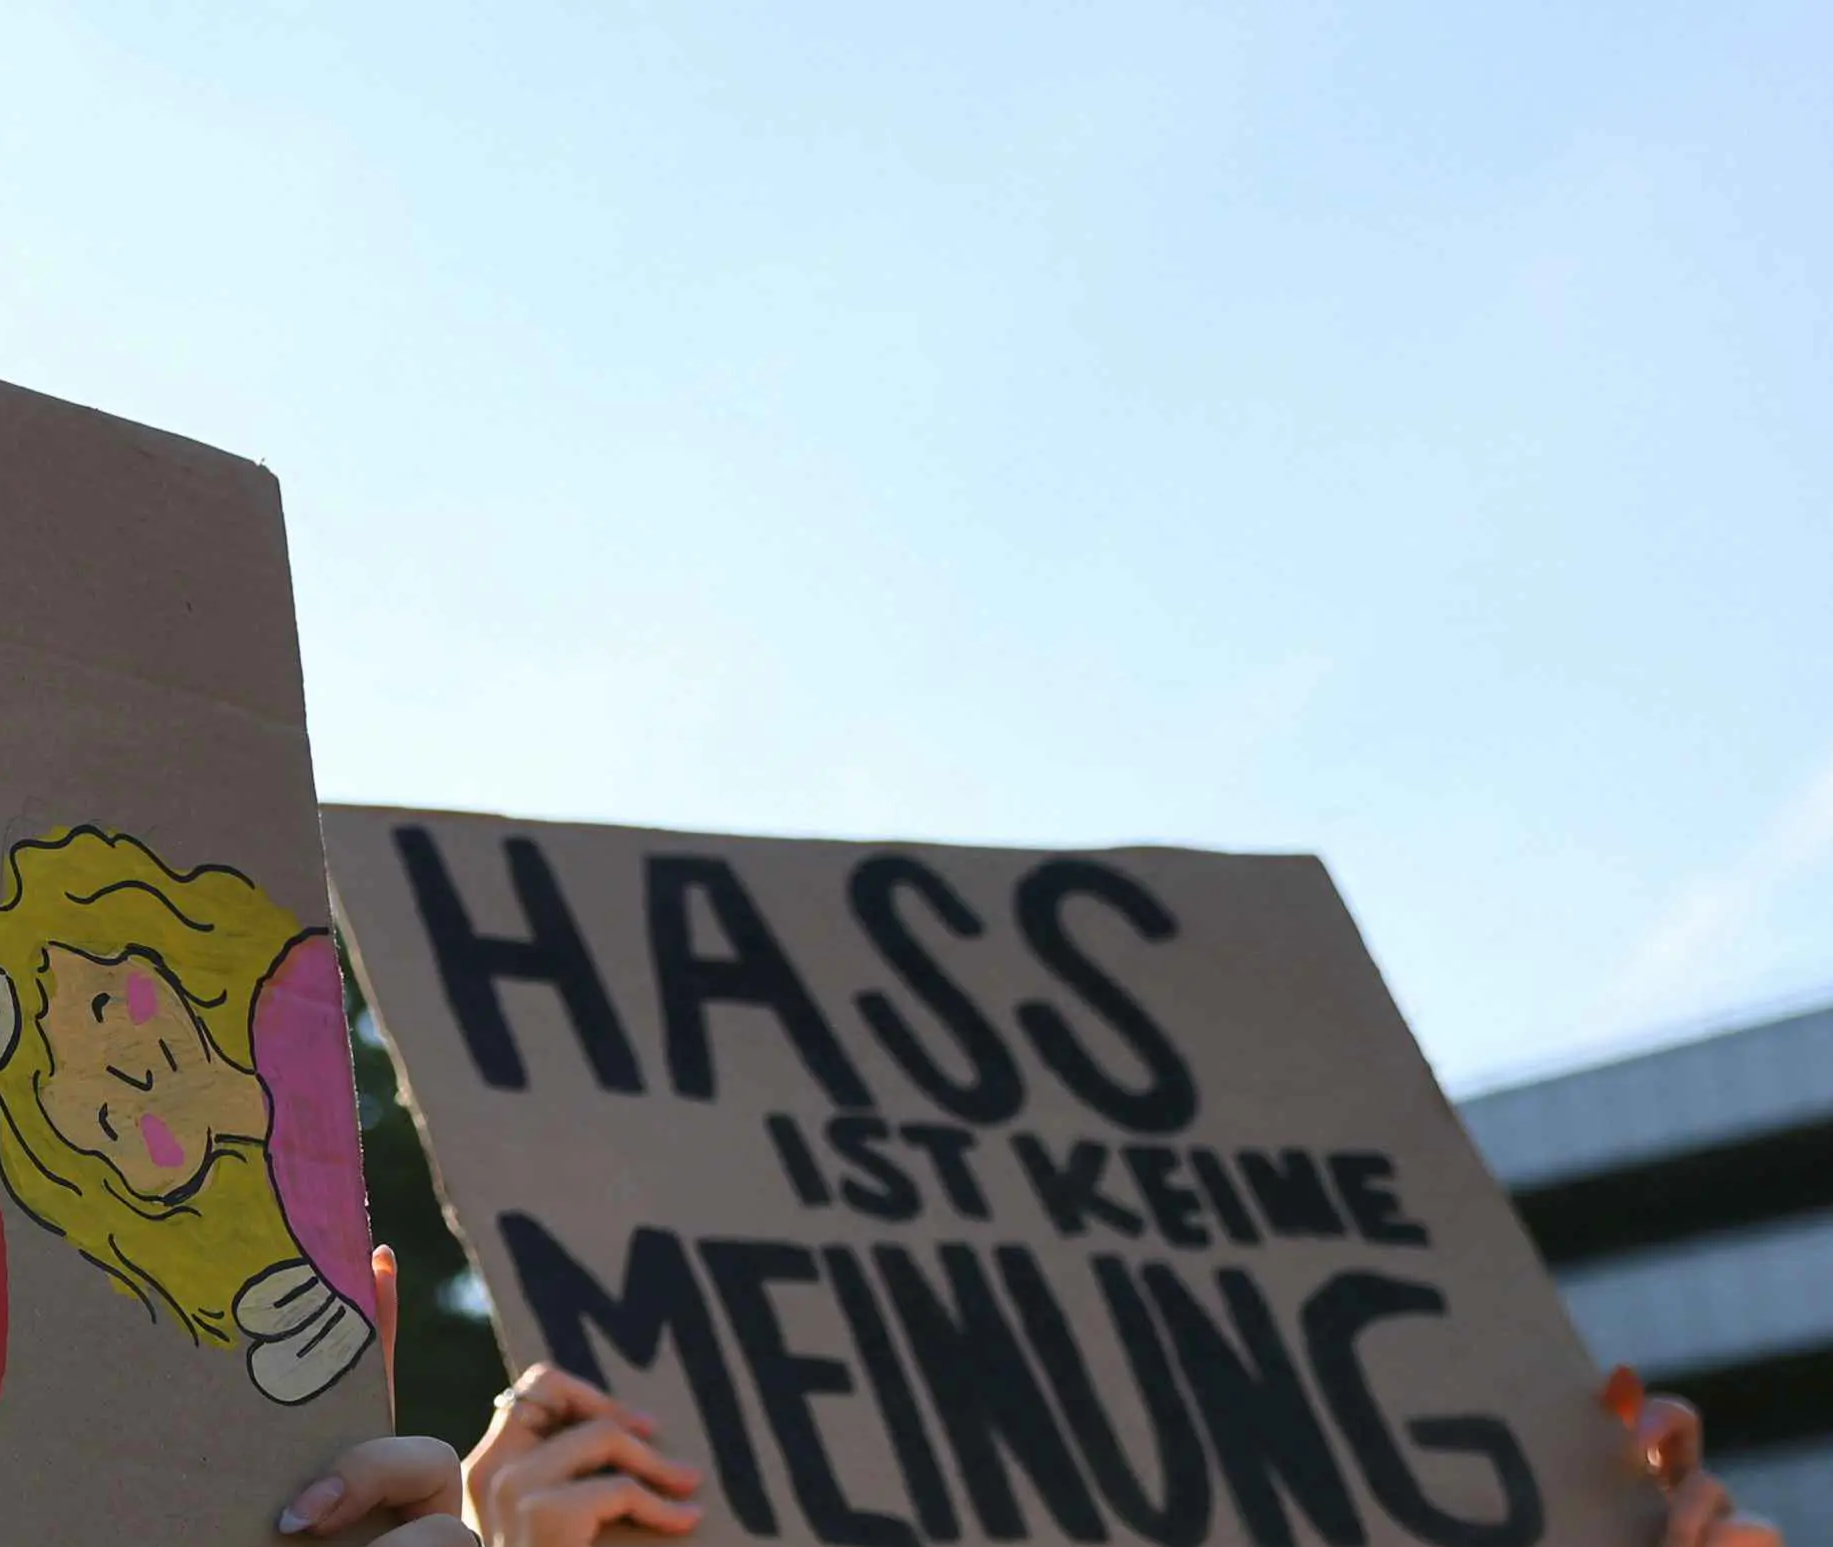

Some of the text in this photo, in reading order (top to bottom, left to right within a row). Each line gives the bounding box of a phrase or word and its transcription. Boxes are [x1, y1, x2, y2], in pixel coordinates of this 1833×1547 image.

[392, 824, 1201, 1134] HASS
[763, 1111, 1434, 1252] IST KEINE
